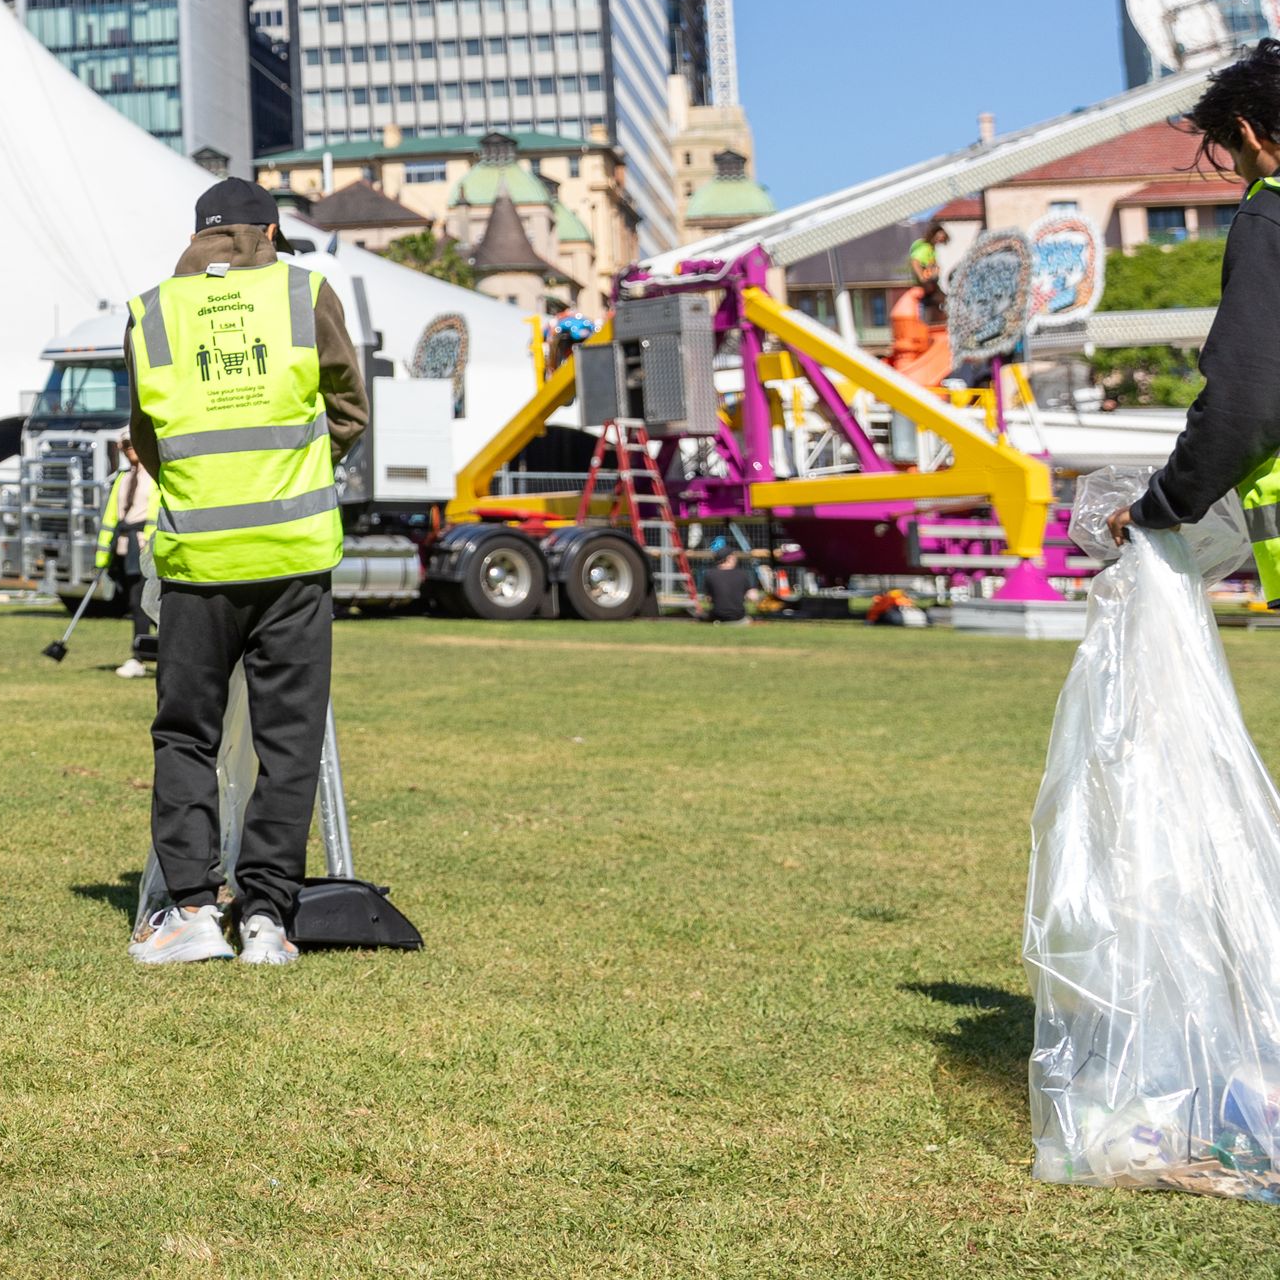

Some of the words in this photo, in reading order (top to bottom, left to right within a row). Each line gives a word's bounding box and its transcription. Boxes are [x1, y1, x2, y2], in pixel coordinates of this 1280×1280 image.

[205, 214, 222, 226] UFC
[207, 291, 241, 302] Social
[197, 302, 254, 316] distancing
